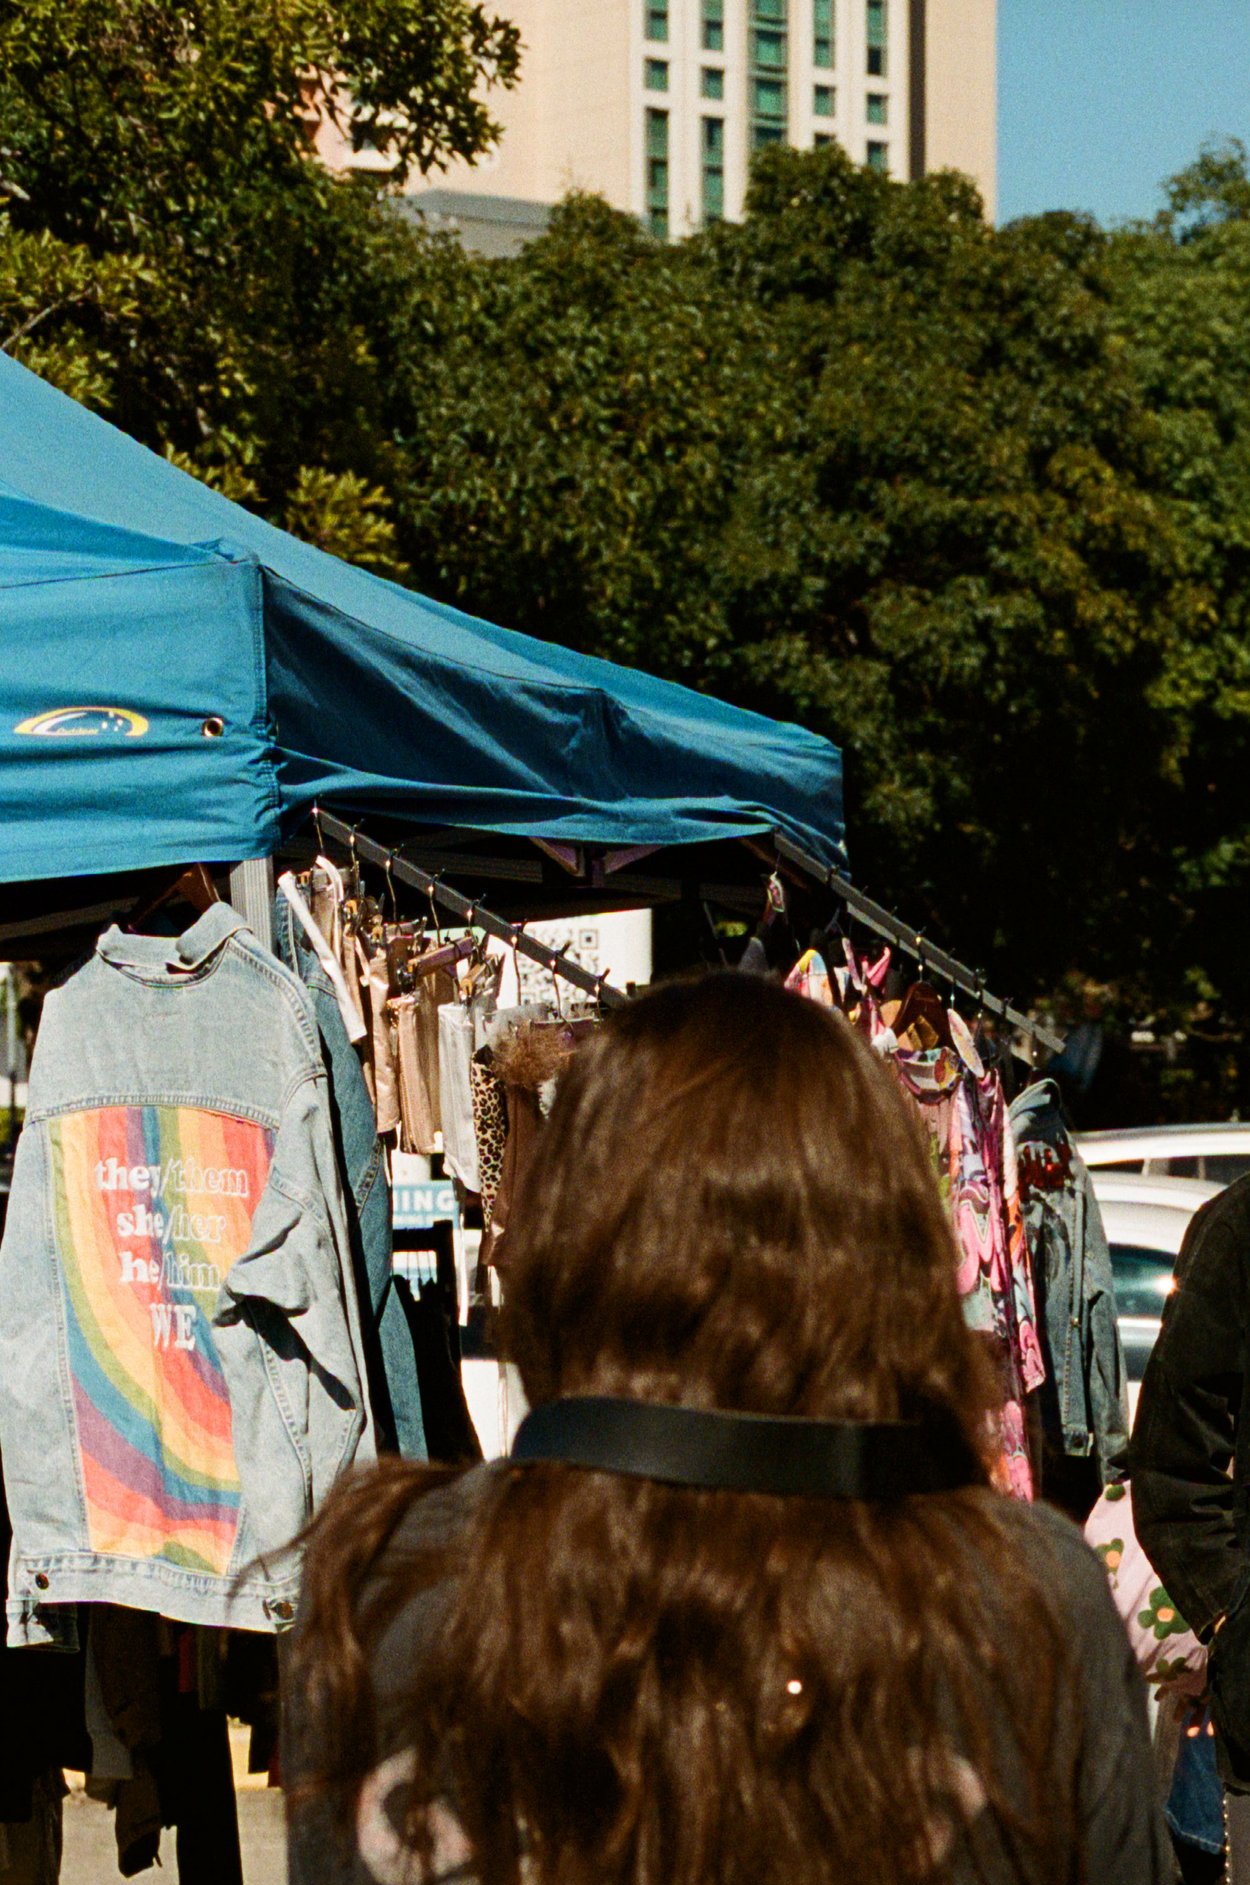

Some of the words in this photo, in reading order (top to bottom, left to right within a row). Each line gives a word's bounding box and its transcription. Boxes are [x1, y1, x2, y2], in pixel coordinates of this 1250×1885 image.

[95, 1157, 249, 1197] they/them
[393, 1188, 455, 1213] ING
[117, 1203, 227, 1245] she/her
[119, 1250, 221, 1291] he/him
[150, 1302, 199, 1352] WE
